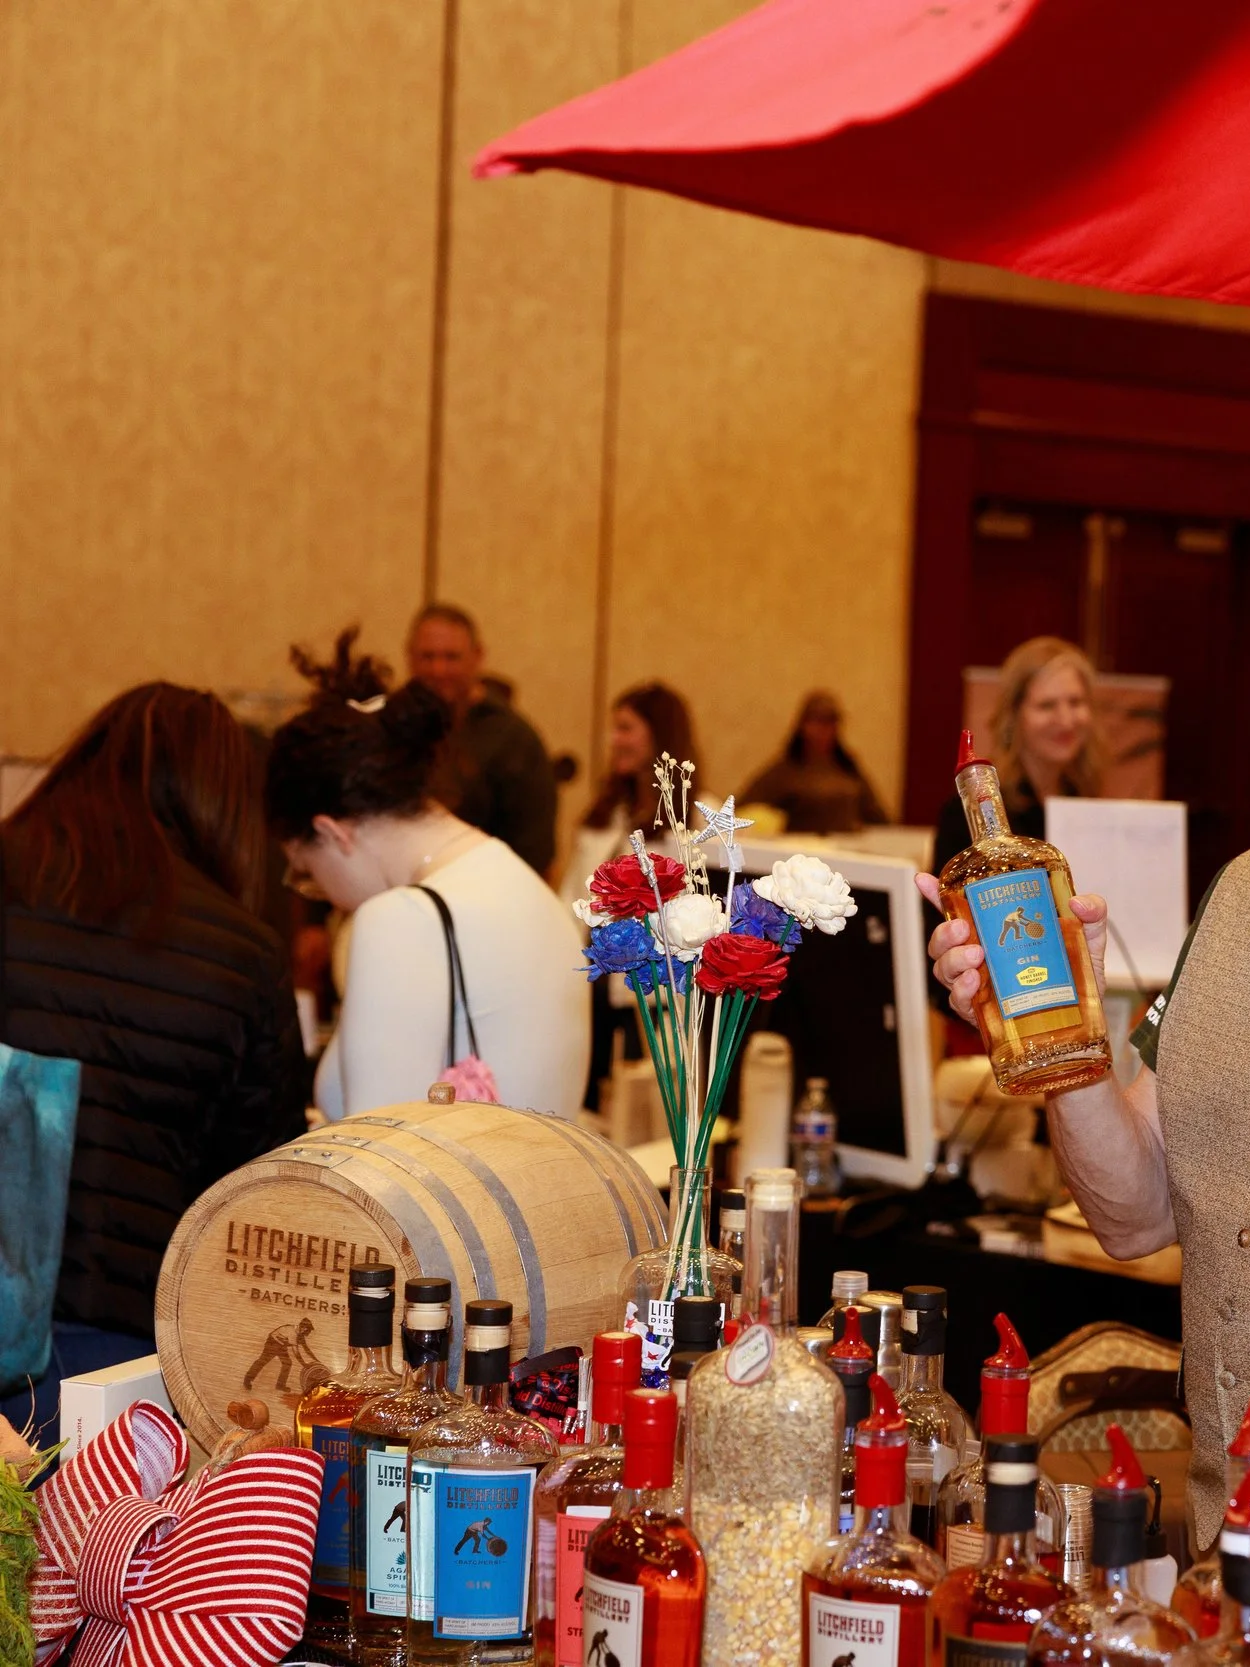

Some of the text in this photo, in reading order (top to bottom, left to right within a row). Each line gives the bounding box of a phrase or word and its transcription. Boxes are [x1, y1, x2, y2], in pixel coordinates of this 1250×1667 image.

[978, 880, 1041, 904] LITCHFIELD
[980, 892, 1041, 910] DISTILLERY
[1016, 954, 1040, 965] GIN
[225, 1258, 342, 1294] DISTILLE
[447, 1486, 519, 1503] LITCHFIELD
[447, 1501, 518, 1511] DISTILLERY
[466, 1580, 492, 1591] GIN
[817, 1609, 885, 1636] LITCHFIELD
